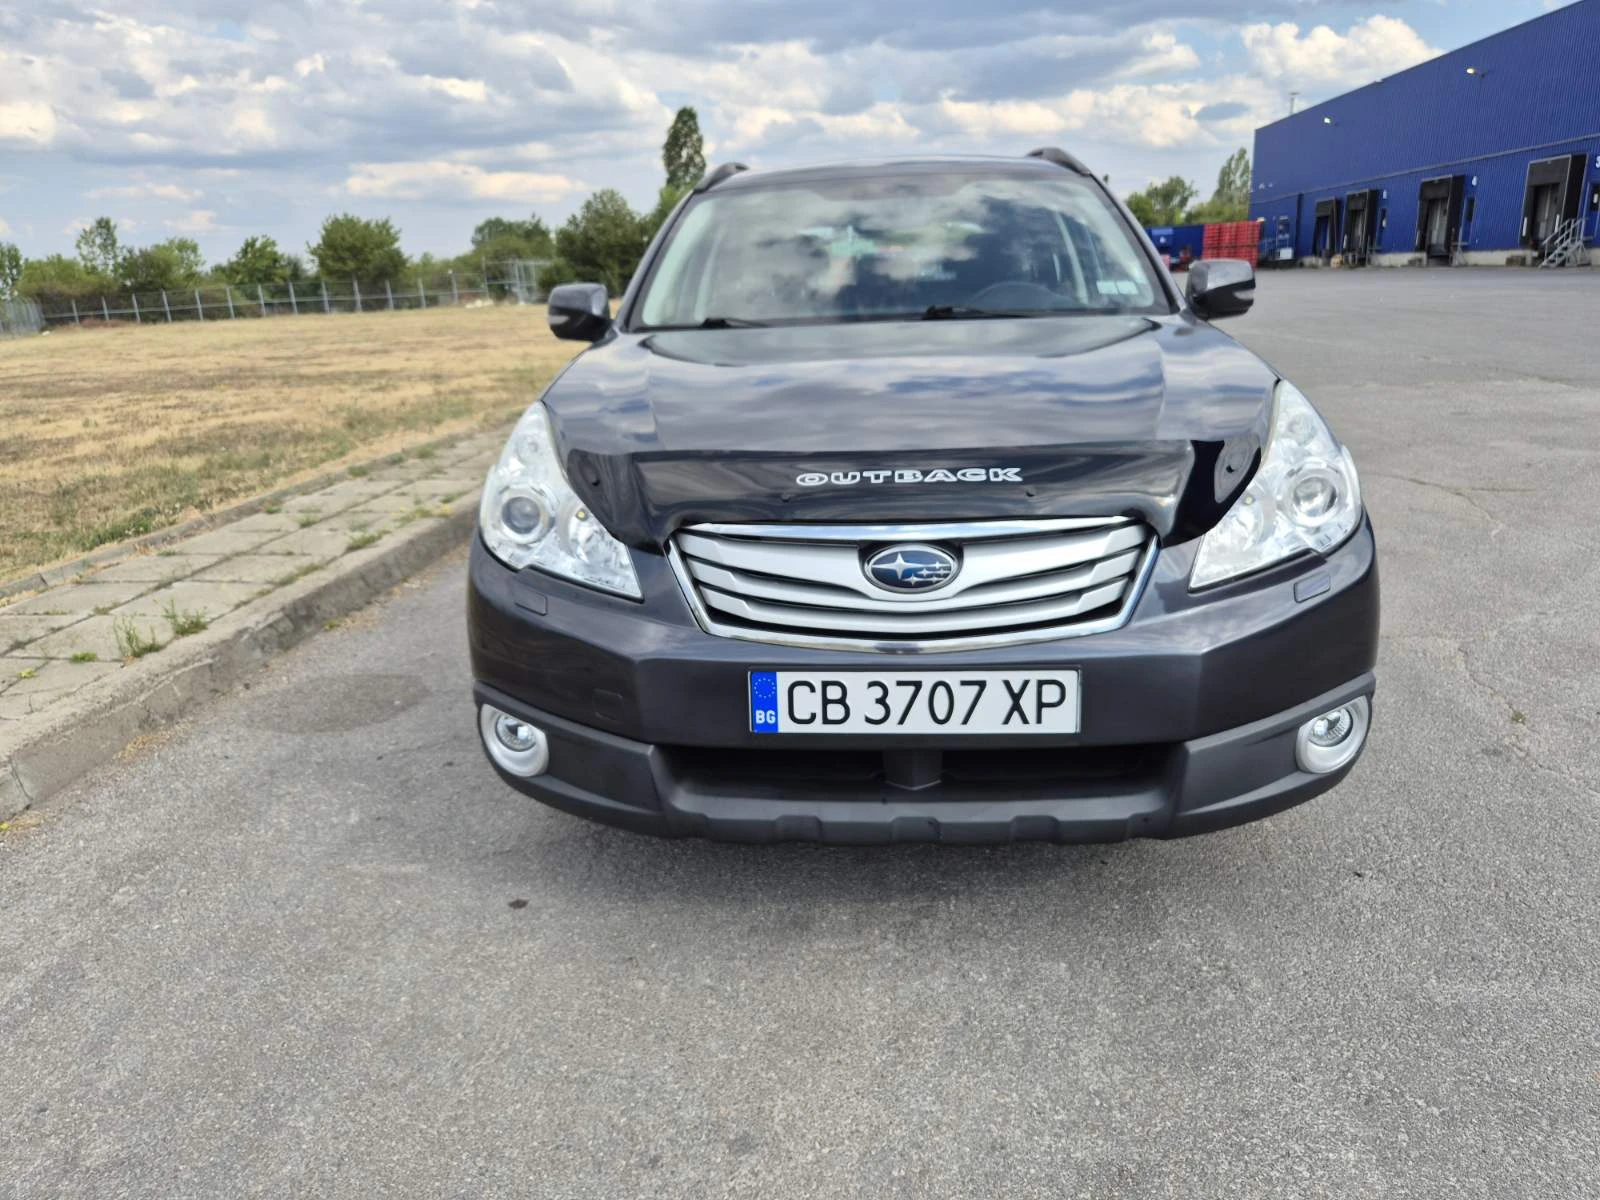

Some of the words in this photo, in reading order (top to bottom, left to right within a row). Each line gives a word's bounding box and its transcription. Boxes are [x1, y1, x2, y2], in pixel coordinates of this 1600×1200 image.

[796, 467, 1023, 486] OUTBACK
[787, 680, 850, 725] CB
[864, 679, 987, 725] 3707
[1002, 679, 1067, 725] XP
[755, 709, 776, 724] BG
